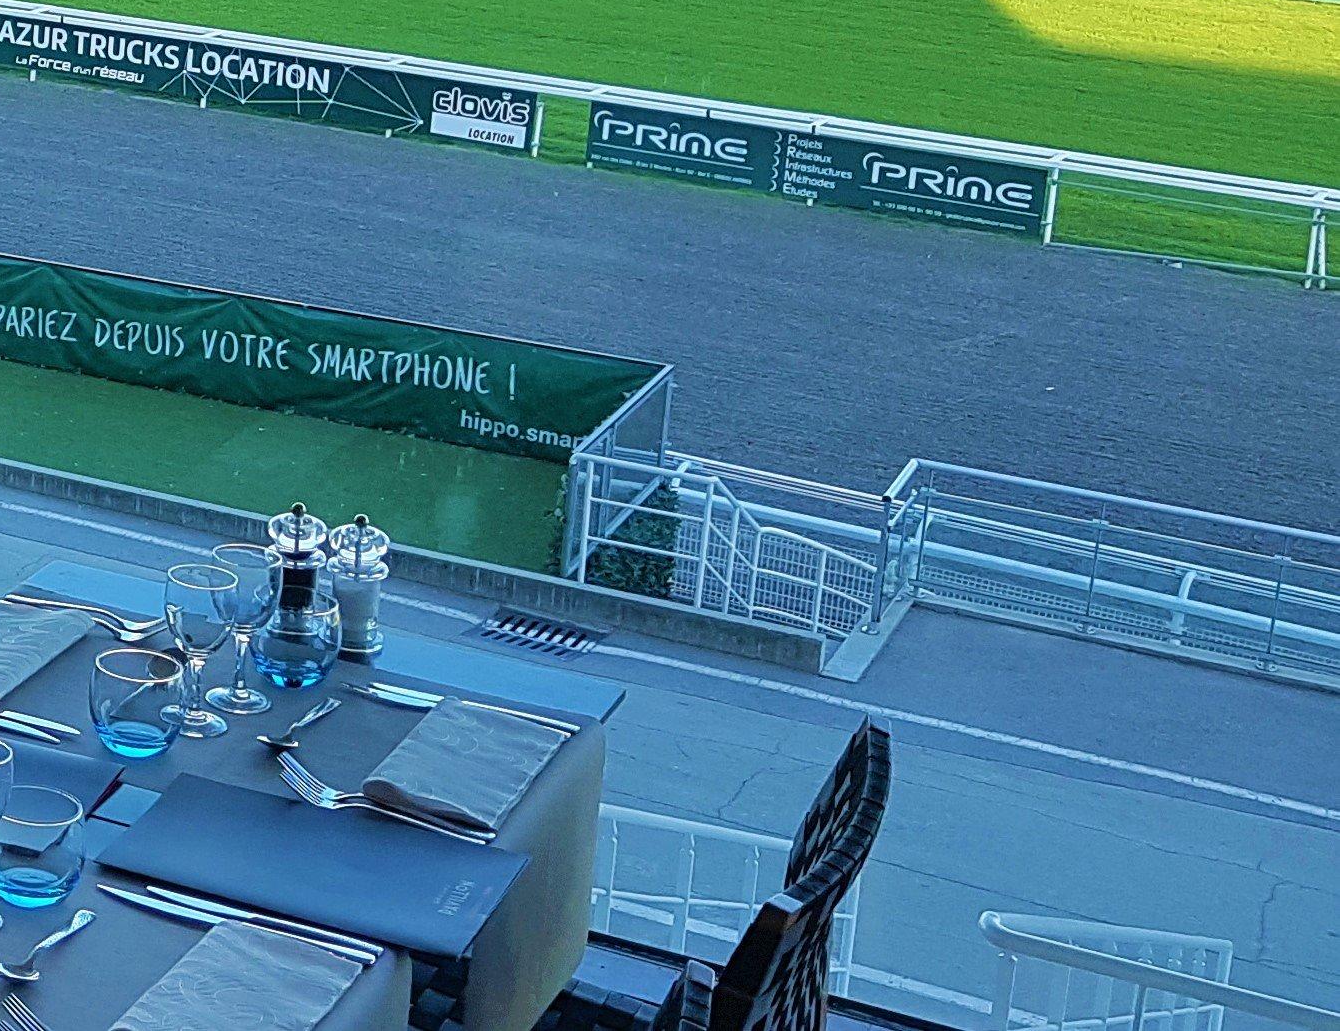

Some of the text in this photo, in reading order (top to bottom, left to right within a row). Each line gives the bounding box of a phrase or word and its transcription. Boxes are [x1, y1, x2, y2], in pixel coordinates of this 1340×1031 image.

[28, 54, 71, 72] Force
[91, 66, 145, 84] réseau
[72, 30, 181, 70] TRUCKS
[186, 47, 331, 95] LOCATION
[467, 127, 515, 145] LOCATION
[787, 133, 824, 150] Projets
[94, 317, 185, 358] DEPUIS
[201, 329, 292, 371] VOTRE
[307, 342, 491, 395] SMARTPHONE
[459, 408, 587, 450] hippo.smar
